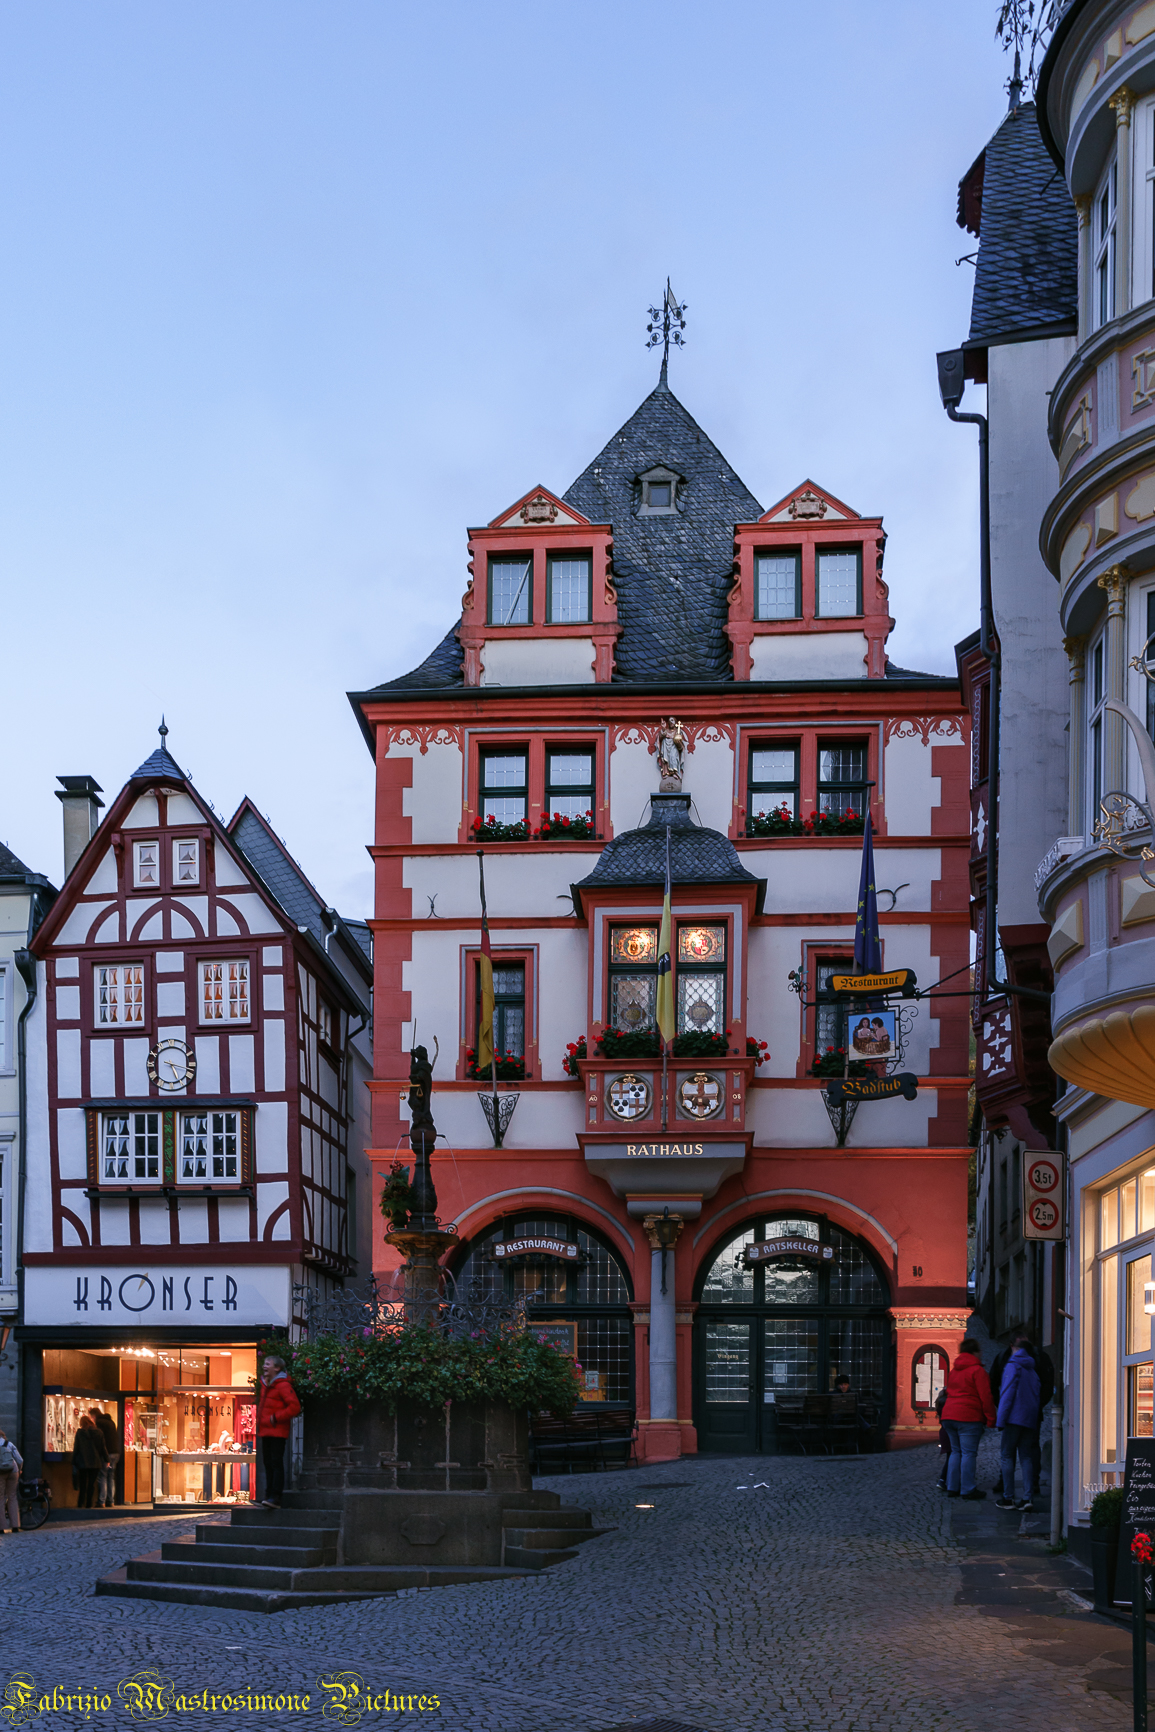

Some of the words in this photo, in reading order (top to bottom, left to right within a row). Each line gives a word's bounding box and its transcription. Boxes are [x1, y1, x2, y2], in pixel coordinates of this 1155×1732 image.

[840, 976, 899, 989] Restaurant
[626, 1143, 704, 1156] RATHAUS
[506, 1239, 566, 1253] RESTAURANT
[763, 1241, 819, 1254] RATSKELLER
[73, 1273, 238, 1312] KRONSER
